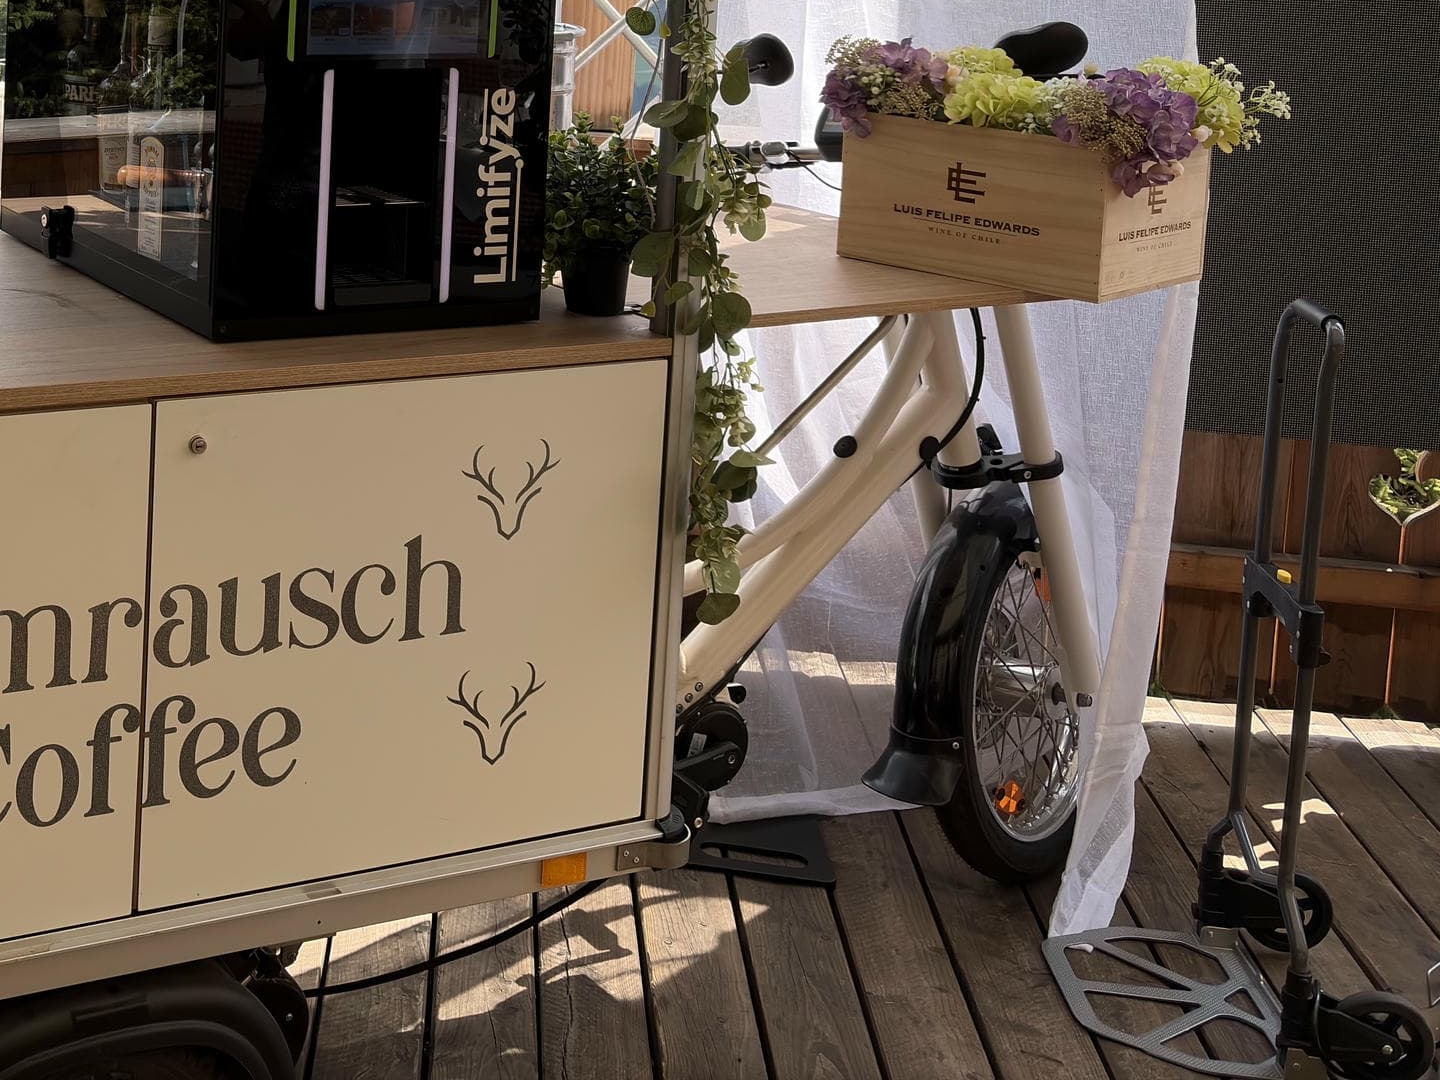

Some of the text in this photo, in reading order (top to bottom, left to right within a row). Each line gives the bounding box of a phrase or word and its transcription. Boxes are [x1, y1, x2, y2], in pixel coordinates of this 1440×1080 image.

[473, 88, 523, 284] Limifyze
[894, 203, 1041, 236] LUIS FELIPE EDWARDS
[1118, 221, 1192, 242] LUIS FELIPE EDWARDS
[928, 226, 952, 236] WINE
[971, 235, 1001, 245] CHILE
